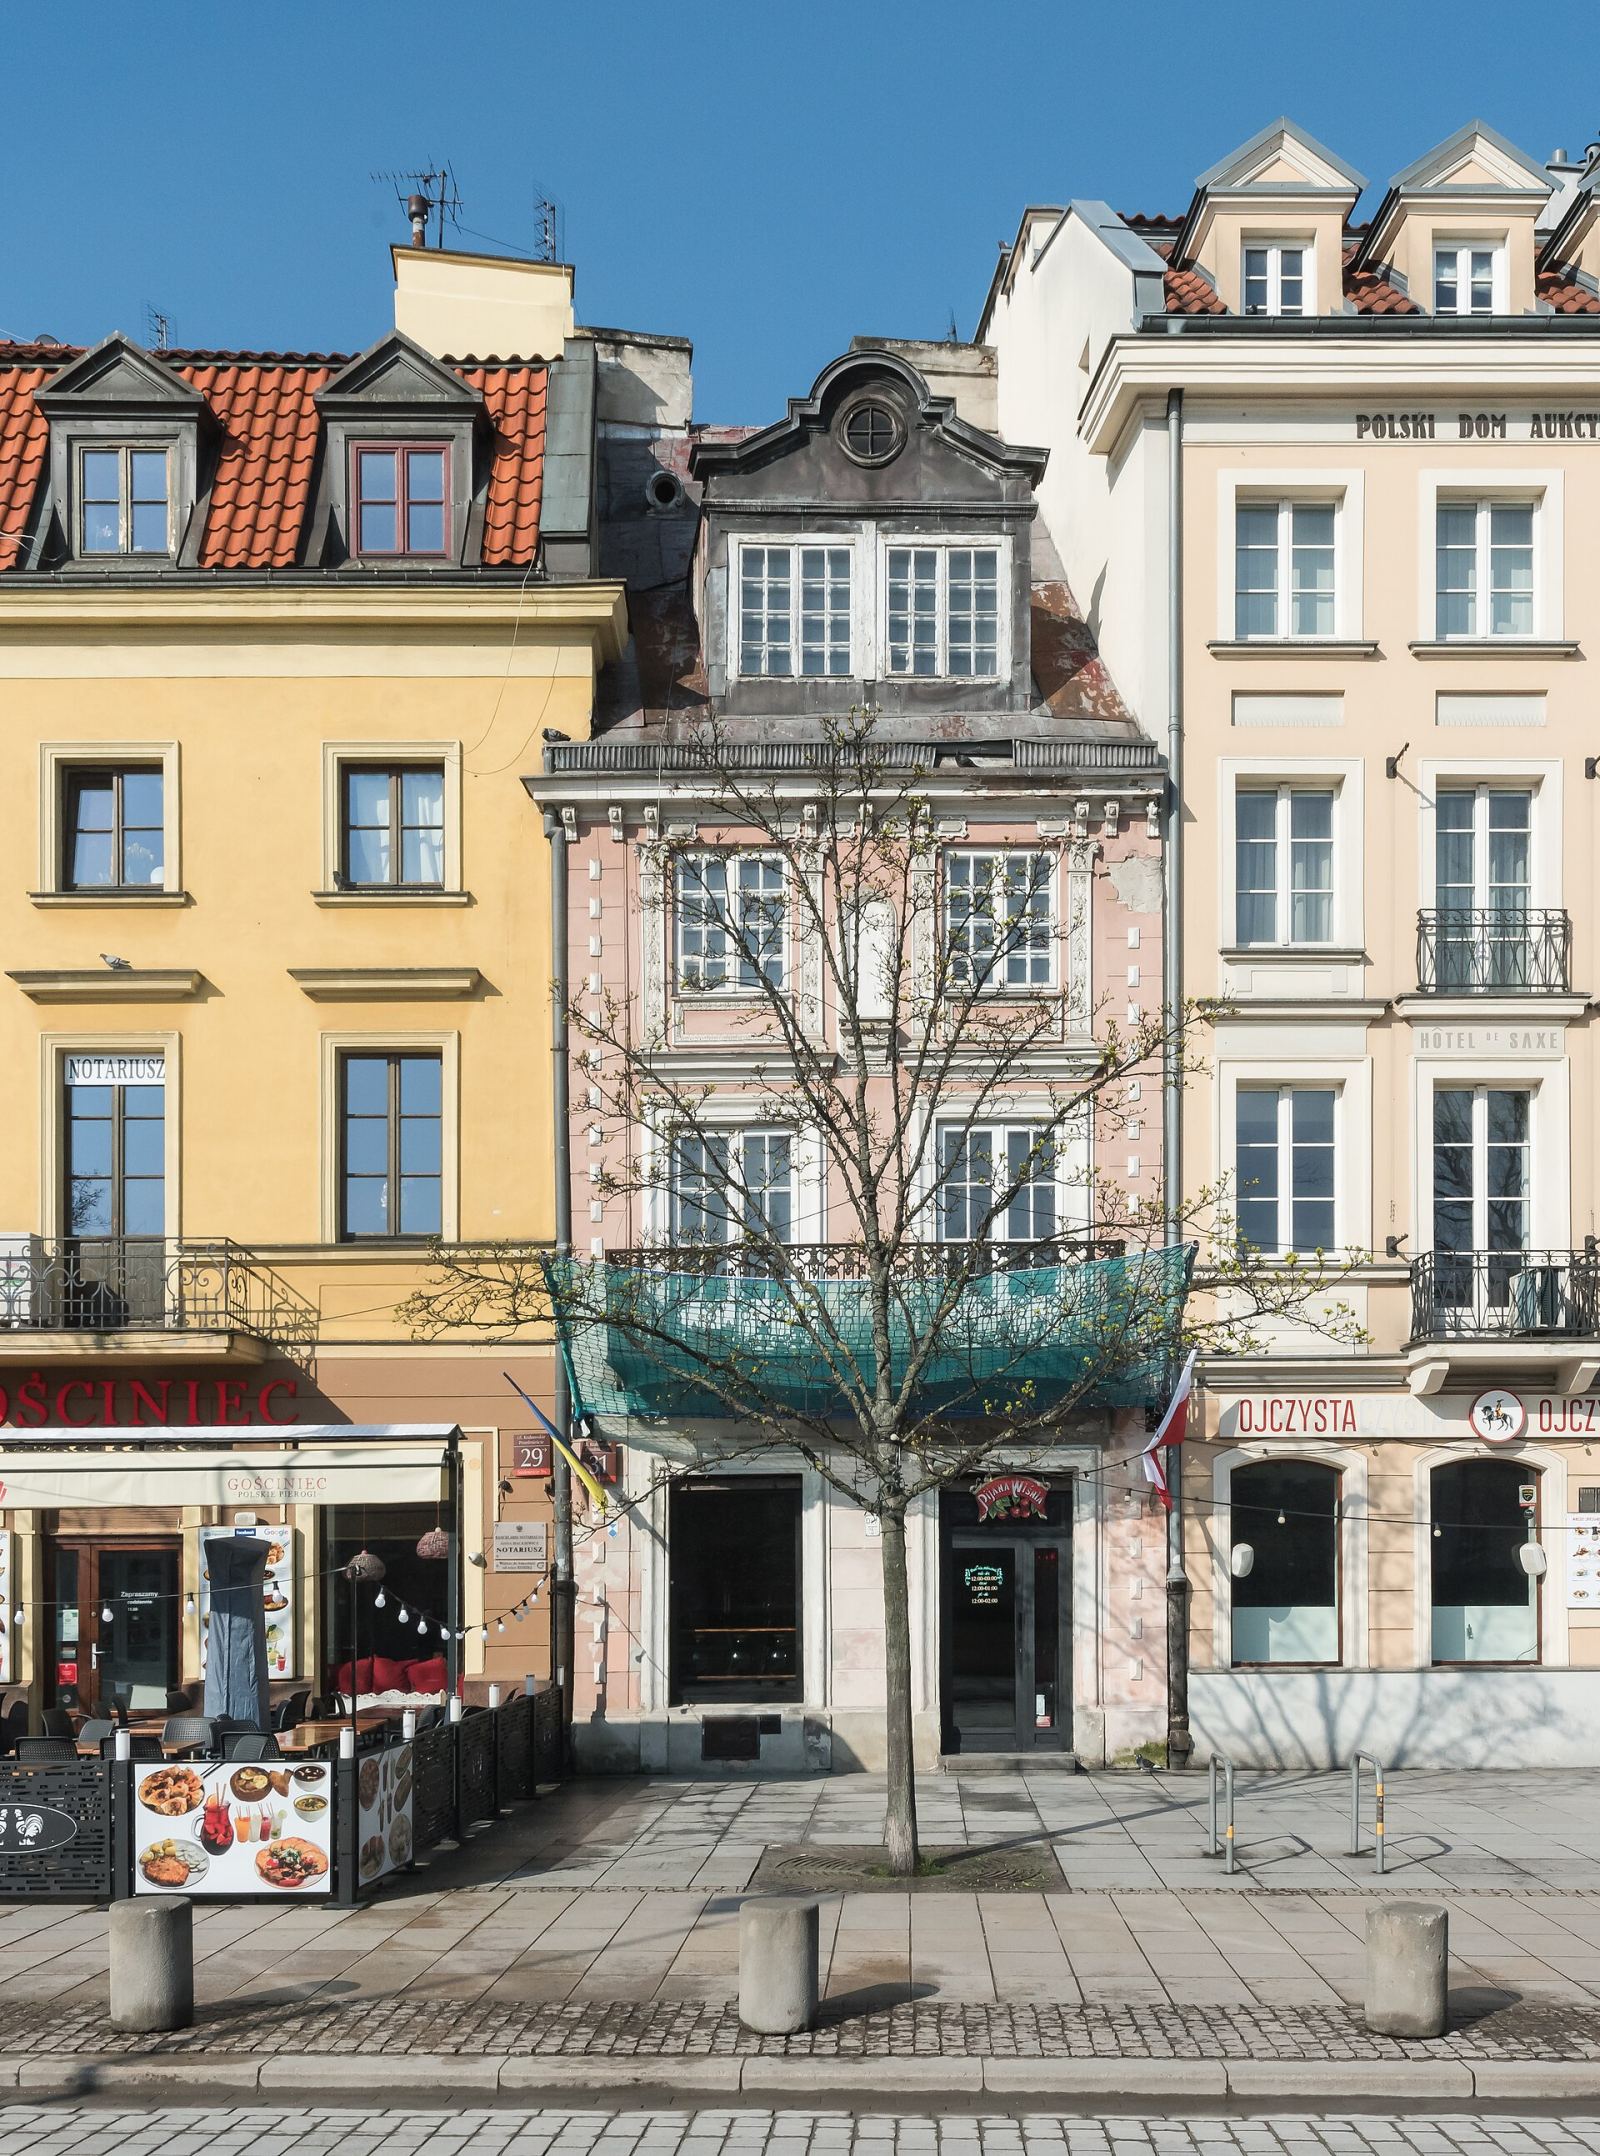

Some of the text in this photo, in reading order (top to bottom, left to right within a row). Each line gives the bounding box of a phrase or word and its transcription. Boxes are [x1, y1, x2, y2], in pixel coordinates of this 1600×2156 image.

[1356, 411, 1600, 439] POLSKI DOM AUKCY
[1420, 1027, 1558, 1049] HÔTEL DE SAXE
[69, 1058, 165, 1079] NOTARIUSZ
[0, 1371, 299, 1427] ŚCINIEC
[1239, 1398, 1357, 1432] OJCZYSTA
[1539, 1398, 1600, 1432] OJCZ
[520, 1447, 543, 1467] 29
[589, 1454, 607, 1475] 31
[227, 1476, 327, 1491] GOŚCINIEC
[238, 1490, 317, 1498] POLSKIE PIEROGI
[263, 1528, 289, 1537] Google
